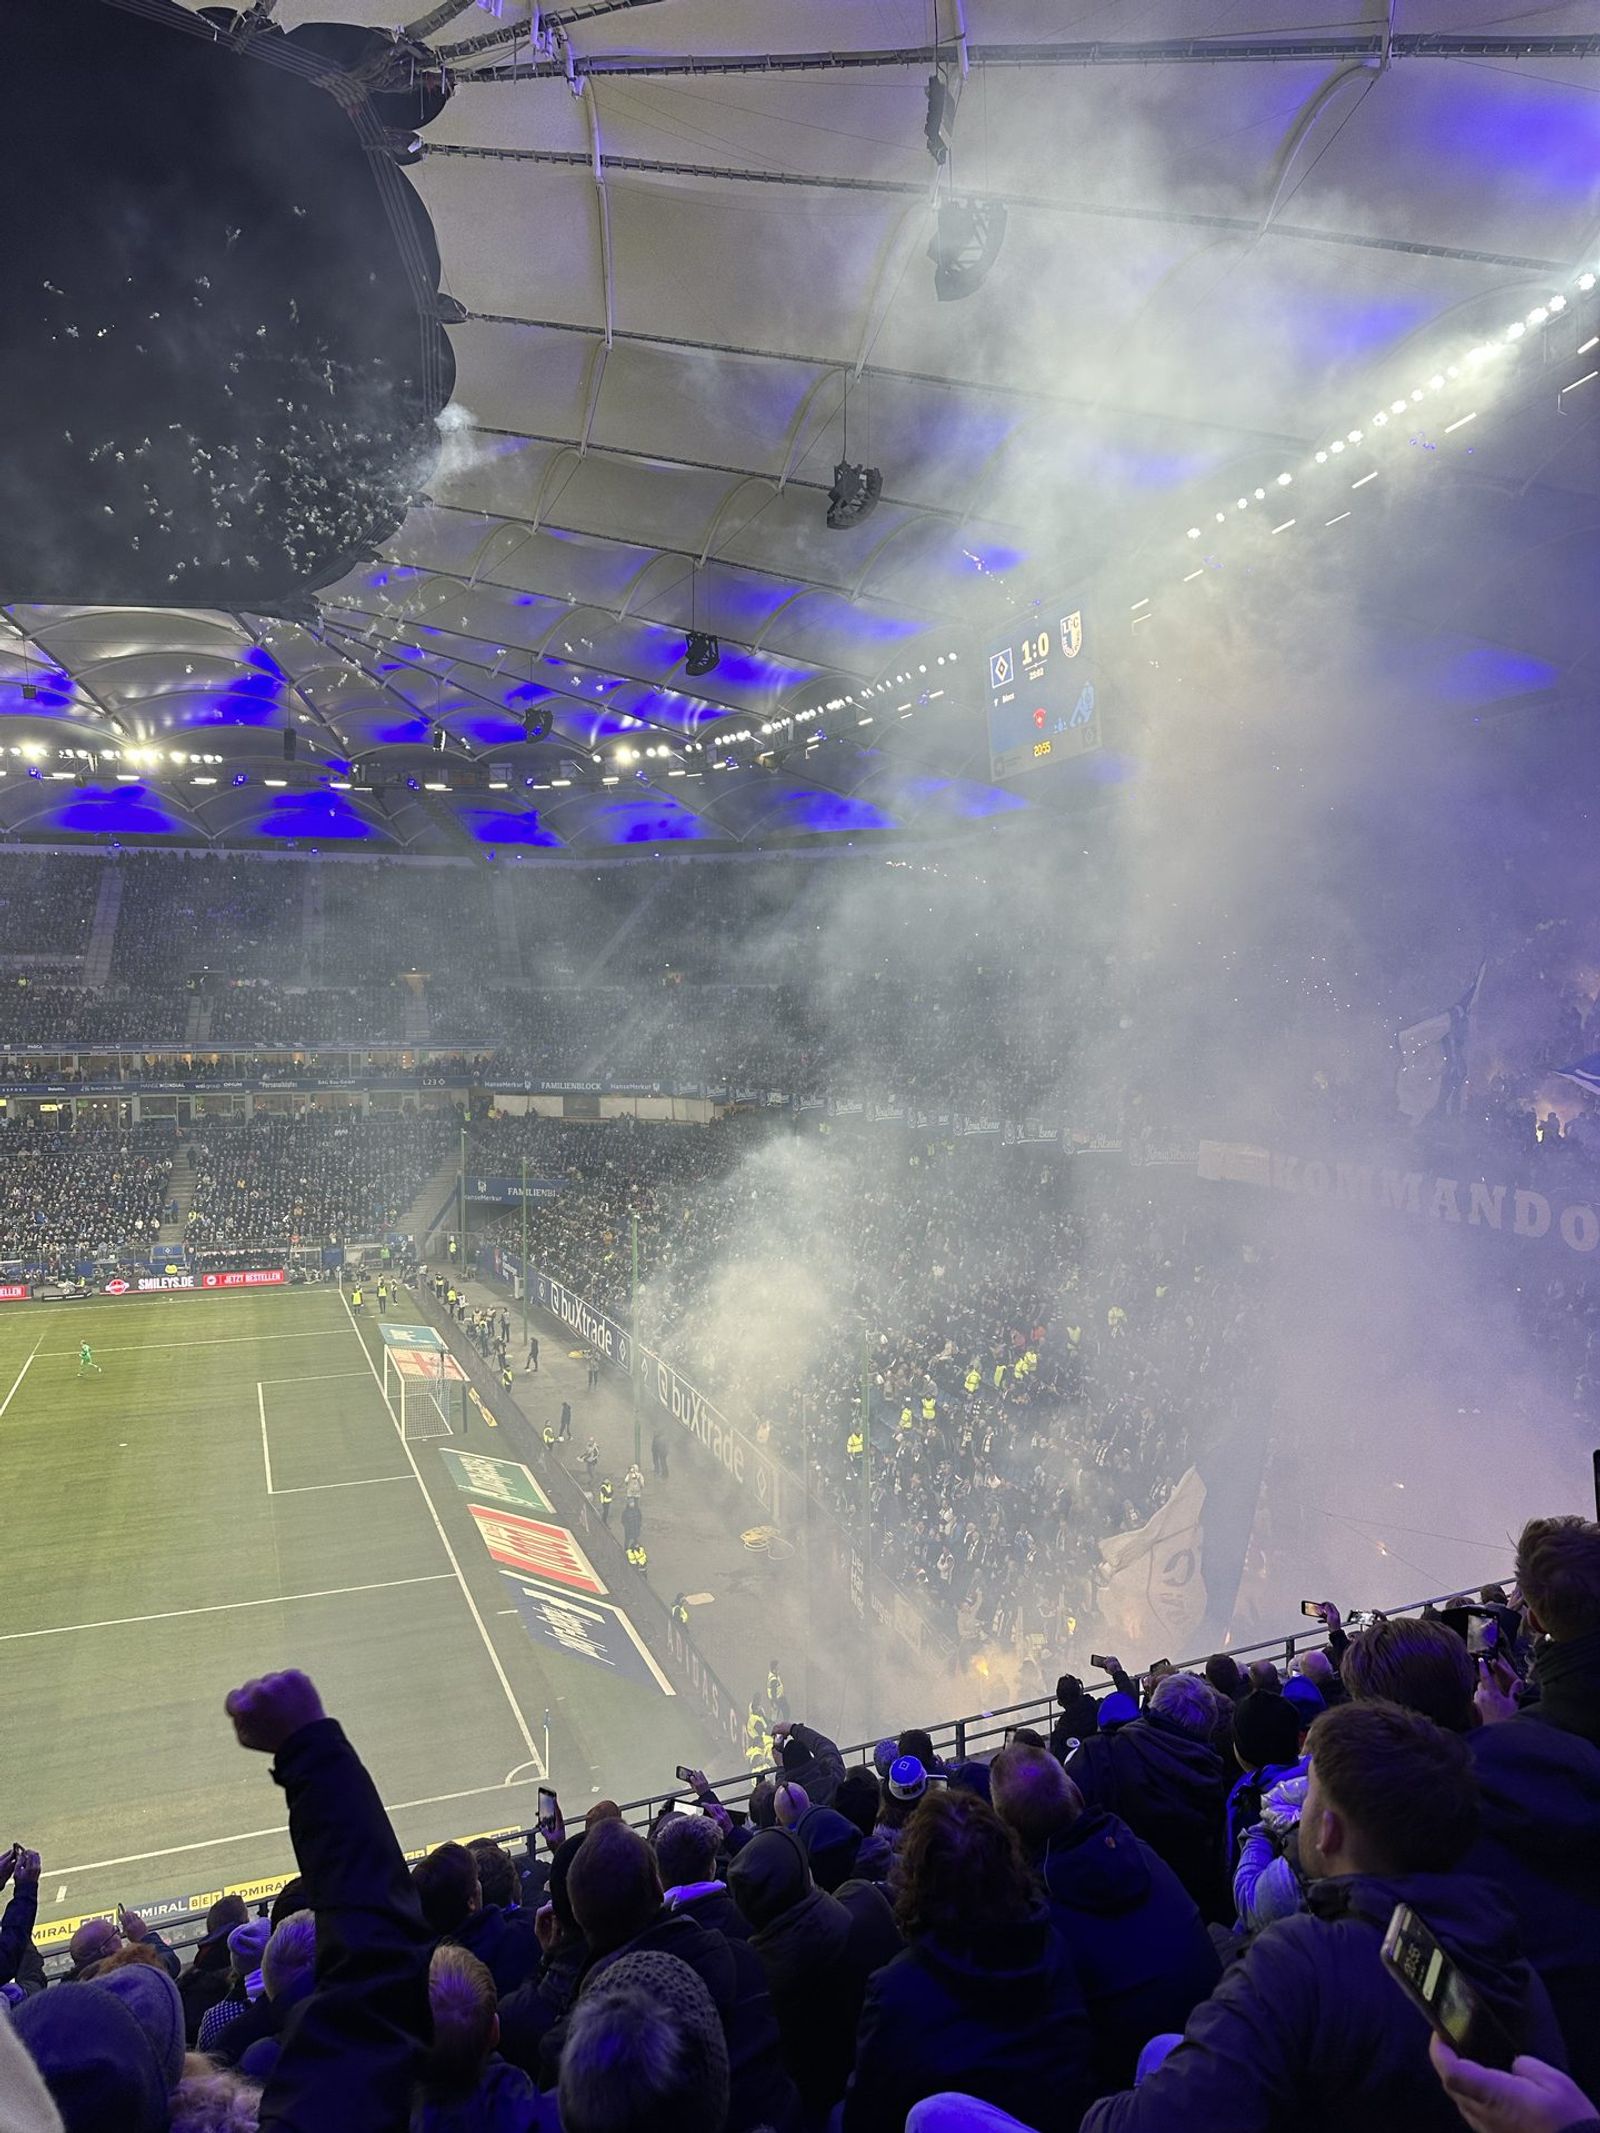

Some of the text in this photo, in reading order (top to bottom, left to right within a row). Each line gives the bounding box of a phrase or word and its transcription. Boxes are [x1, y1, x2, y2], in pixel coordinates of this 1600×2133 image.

[1022, 632, 1049, 665] 1:0
[541, 1081, 601, 1090] FAMILIENBLOCK
[1273, 1152, 1600, 1252] KOMMANDO
[138, 1276, 194, 1290] SMILEYS.DE
[561, 1292, 612, 1356] buXtrade
[672, 1376, 744, 1484] buXtrade
